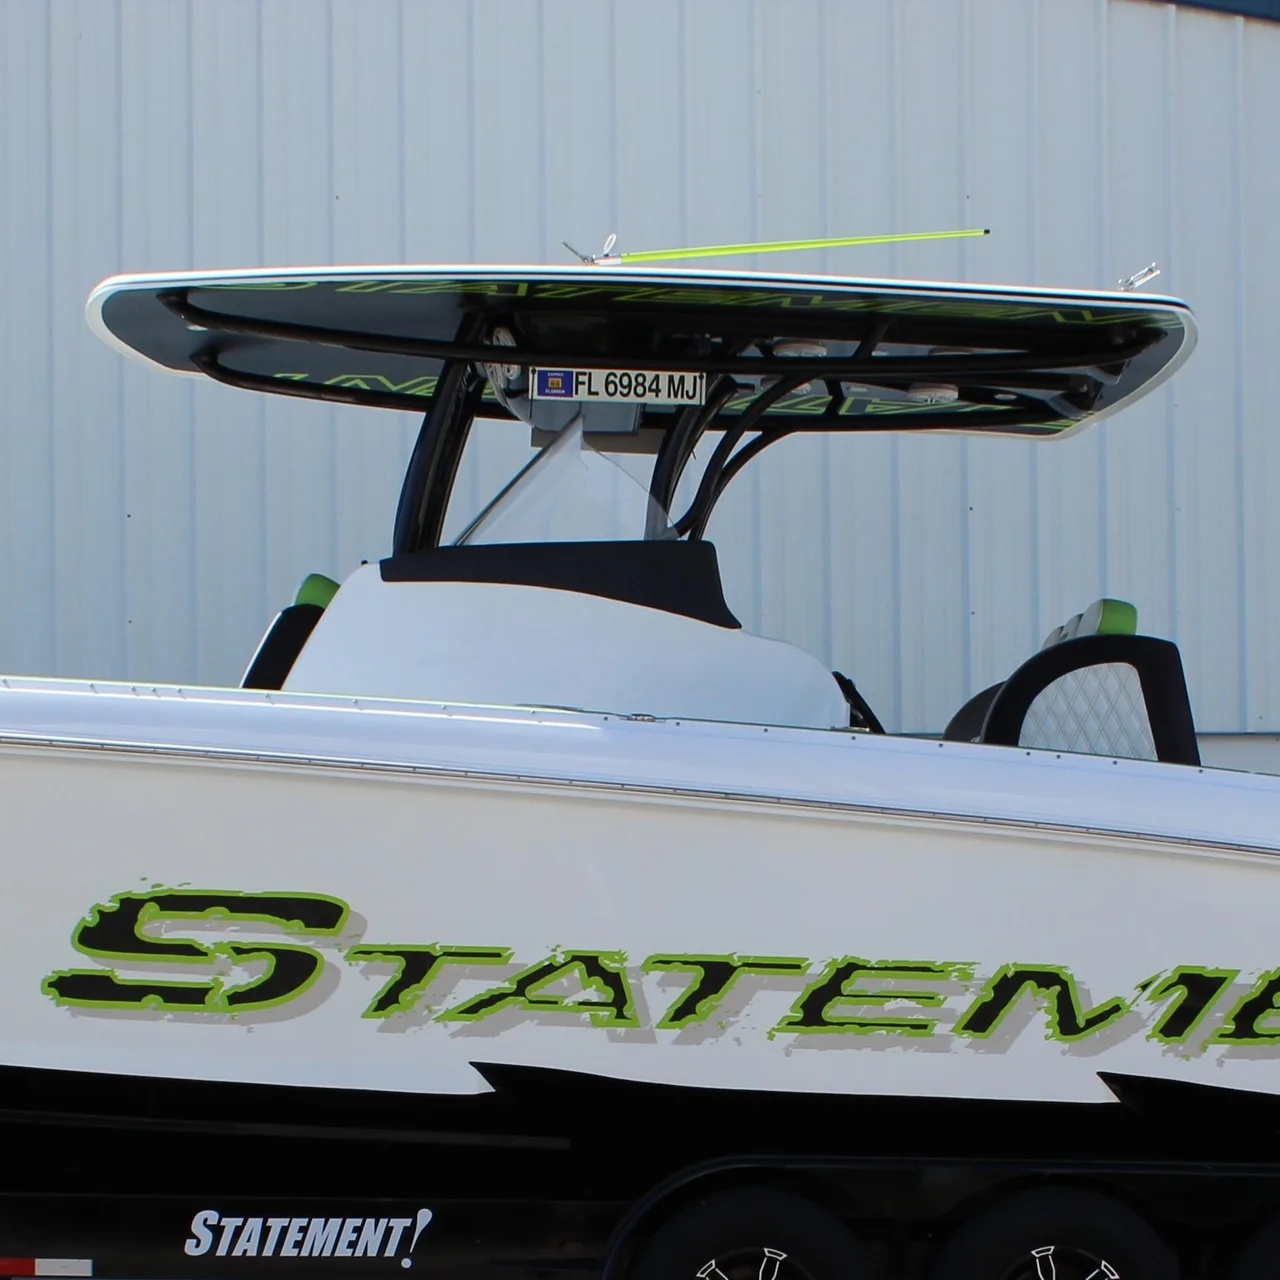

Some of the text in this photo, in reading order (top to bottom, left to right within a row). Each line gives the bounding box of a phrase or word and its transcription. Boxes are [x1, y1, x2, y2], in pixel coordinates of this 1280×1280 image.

[574, 371, 699, 401] FL 6984 MJ
